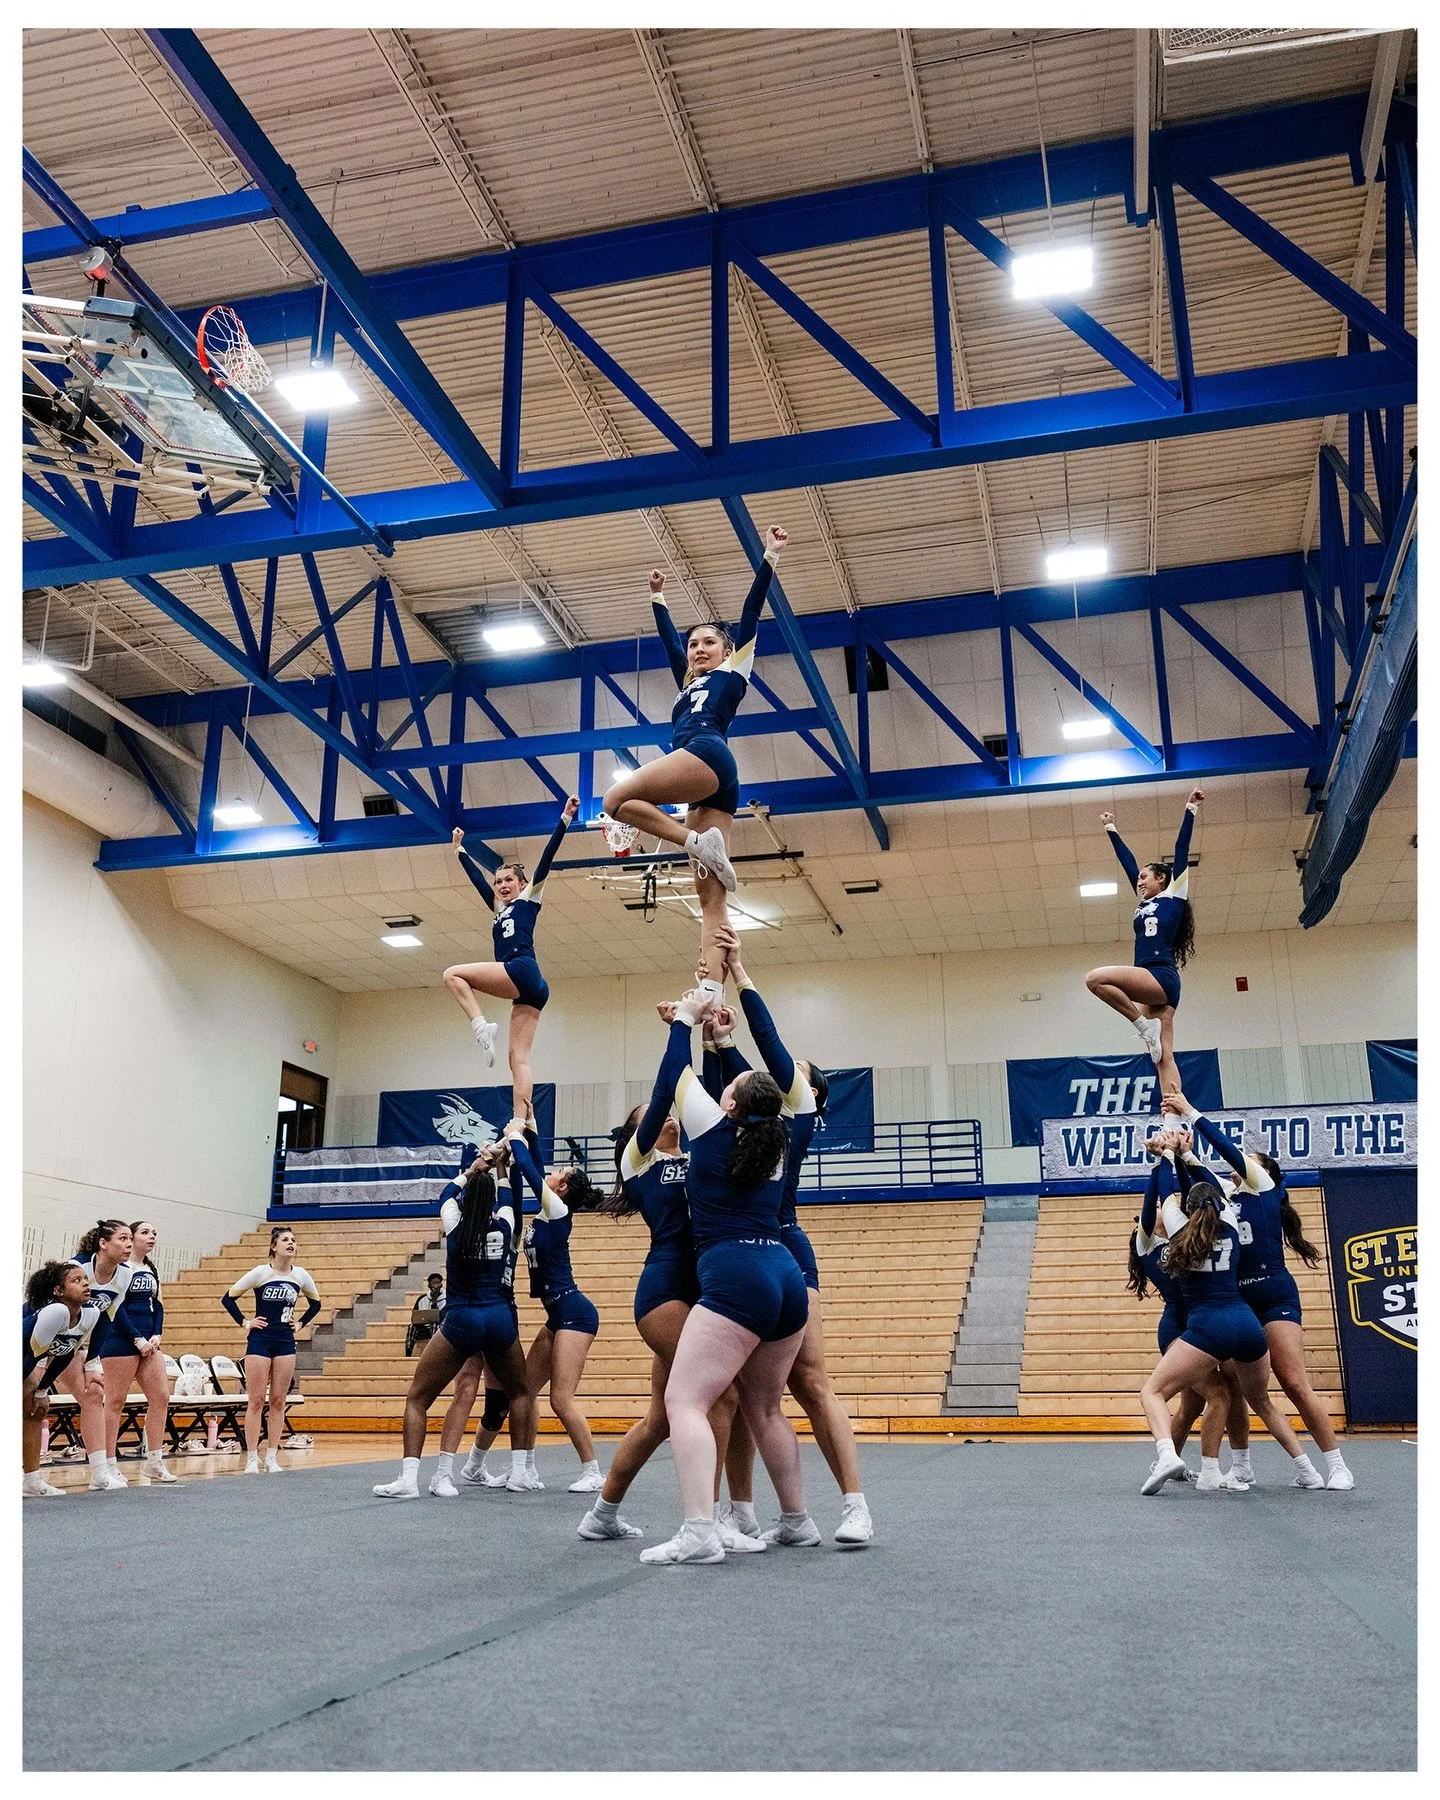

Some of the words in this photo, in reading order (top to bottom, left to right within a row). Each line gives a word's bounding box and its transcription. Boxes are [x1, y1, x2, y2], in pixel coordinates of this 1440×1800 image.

[690, 690, 710, 714] 7
[501, 918, 515, 938] 3
[1069, 1075, 1157, 1117] THE
[1061, 1119, 1244, 1169] WELME
[1260, 1116, 1310, 1159] TO
[1325, 1112, 1406, 1157] THE
[662, 1165, 687, 1182] SE
[1350, 1236, 1392, 1270] ST.
[1396, 1231, 1418, 1261] E
[131, 1276, 153, 1291] SEU
[263, 1286, 288, 1299] SEU
[1406, 1319, 1418, 1328] A
